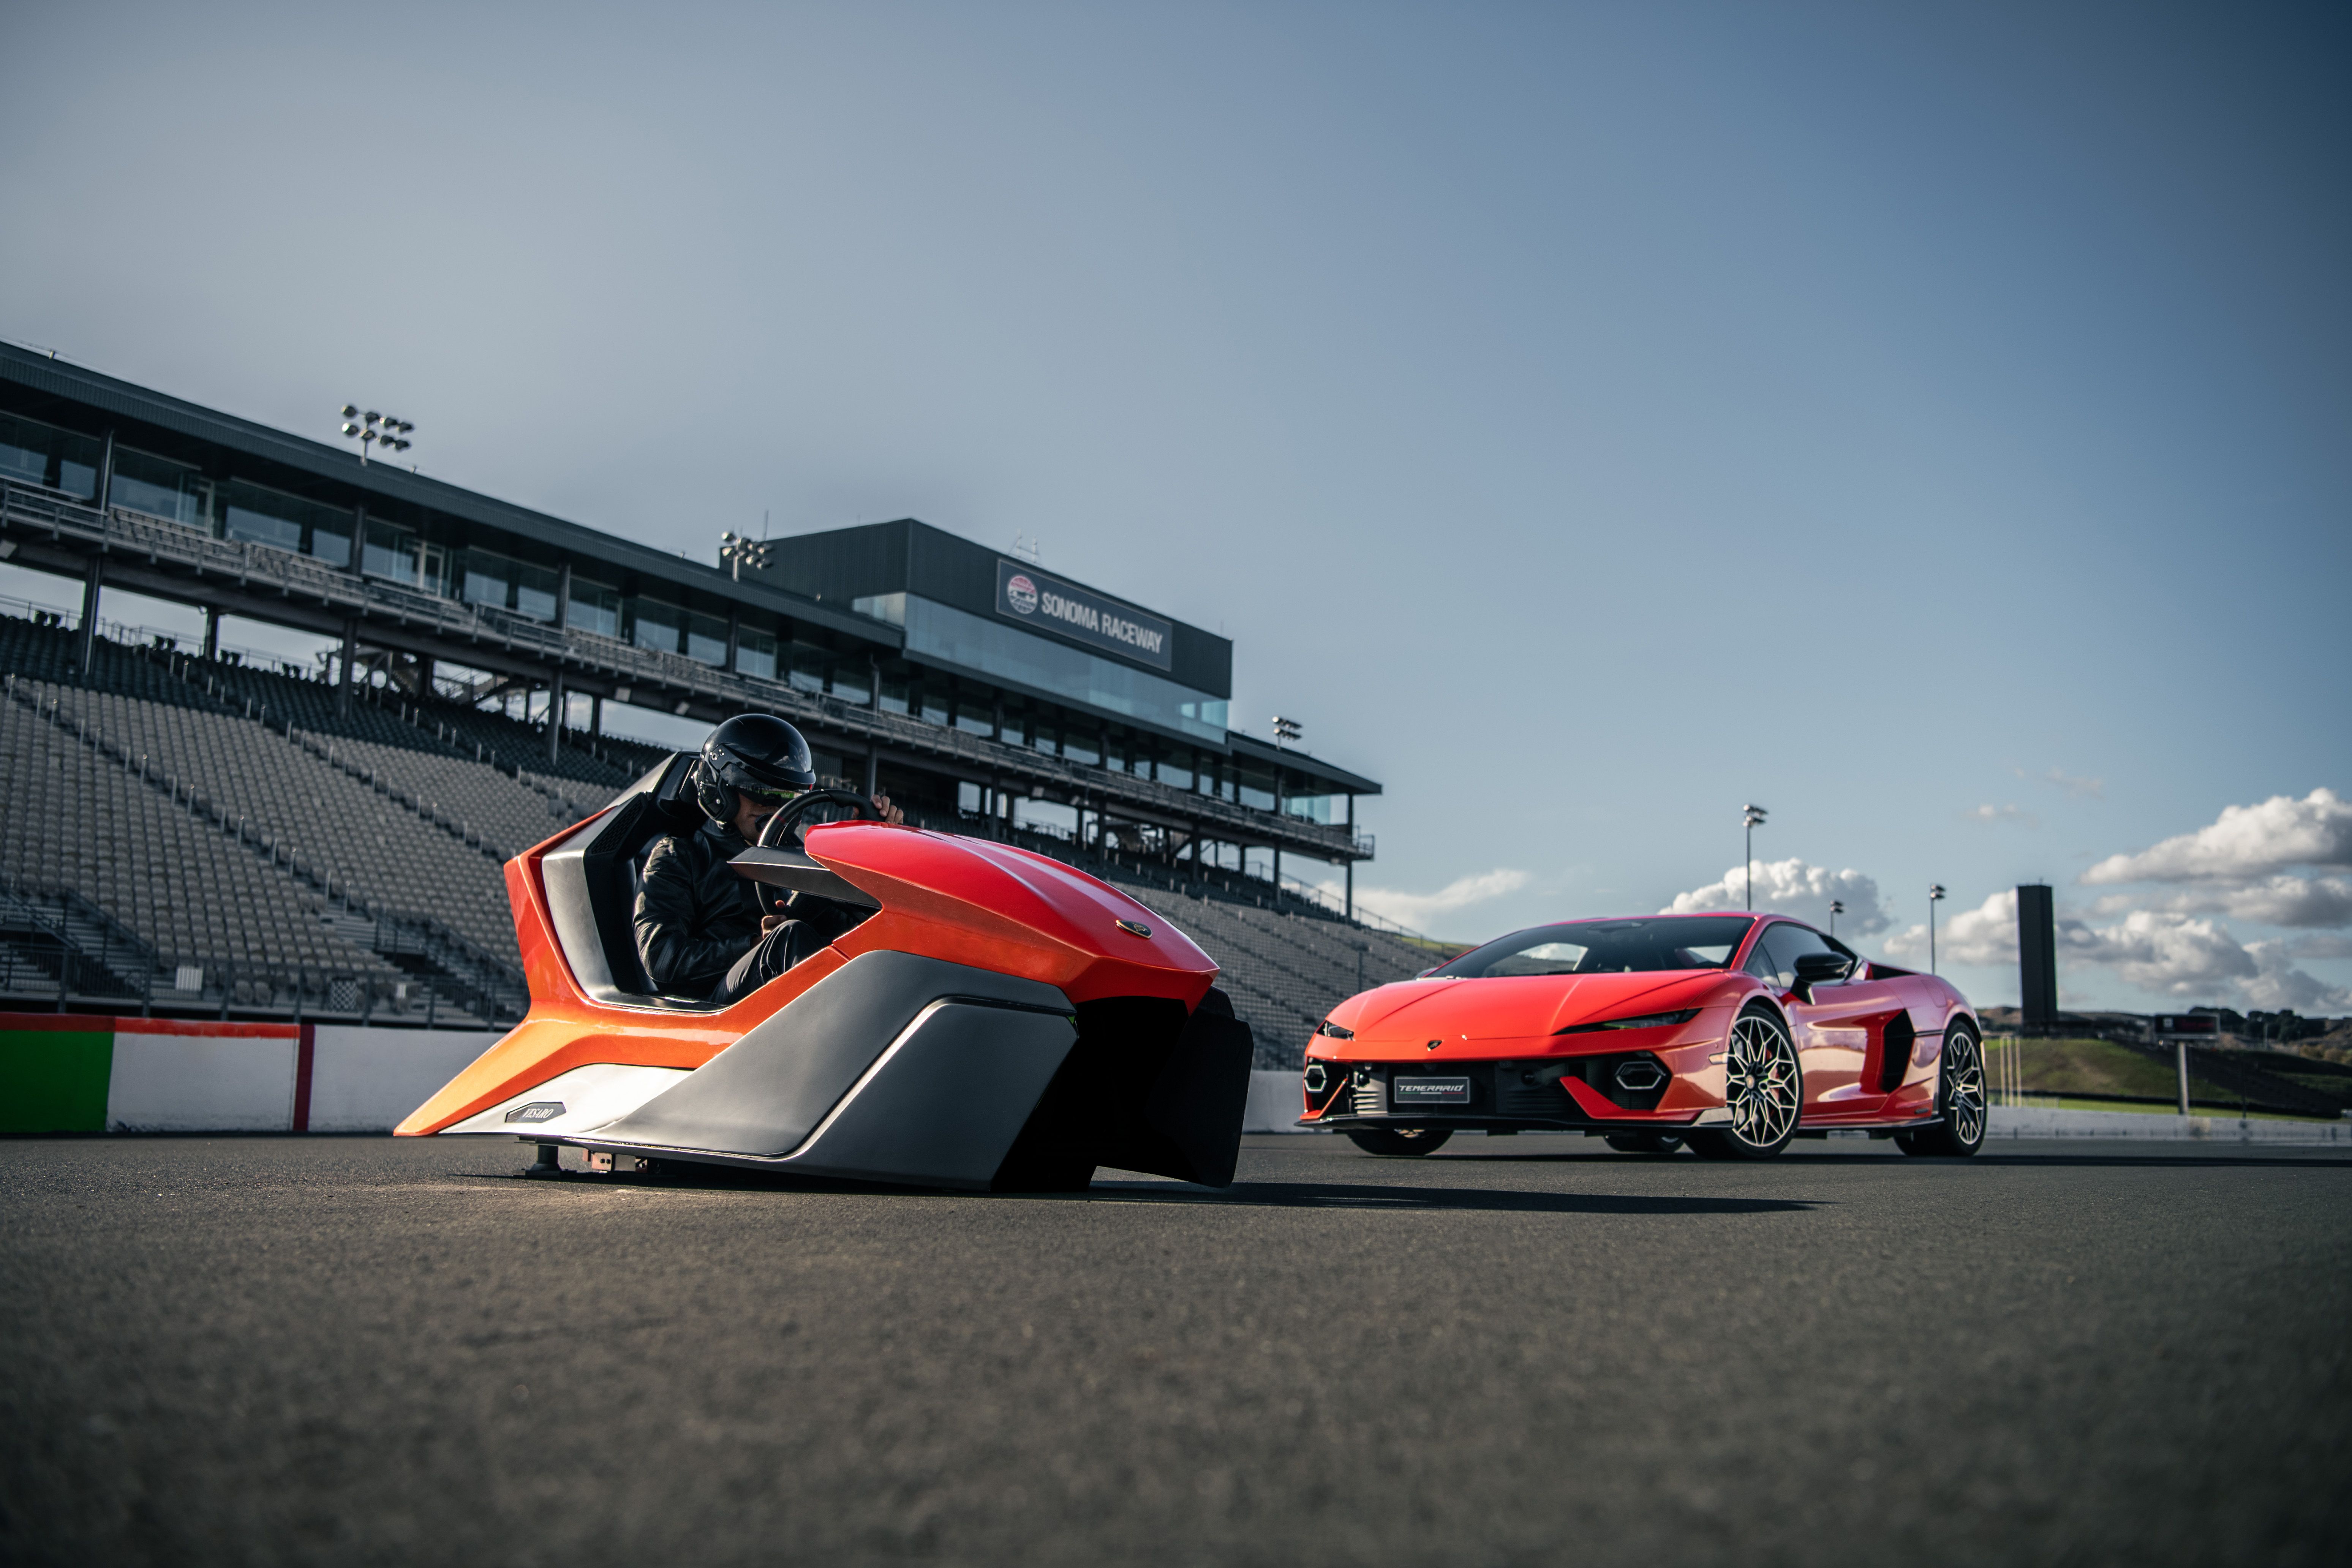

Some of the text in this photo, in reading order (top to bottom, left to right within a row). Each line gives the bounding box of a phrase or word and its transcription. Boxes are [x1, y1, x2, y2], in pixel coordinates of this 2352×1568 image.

[1042, 592, 1099, 632] SONOMA
[1102, 613, 1163, 654] RACEWAY
[522, 1108, 554, 1119] VESARO
